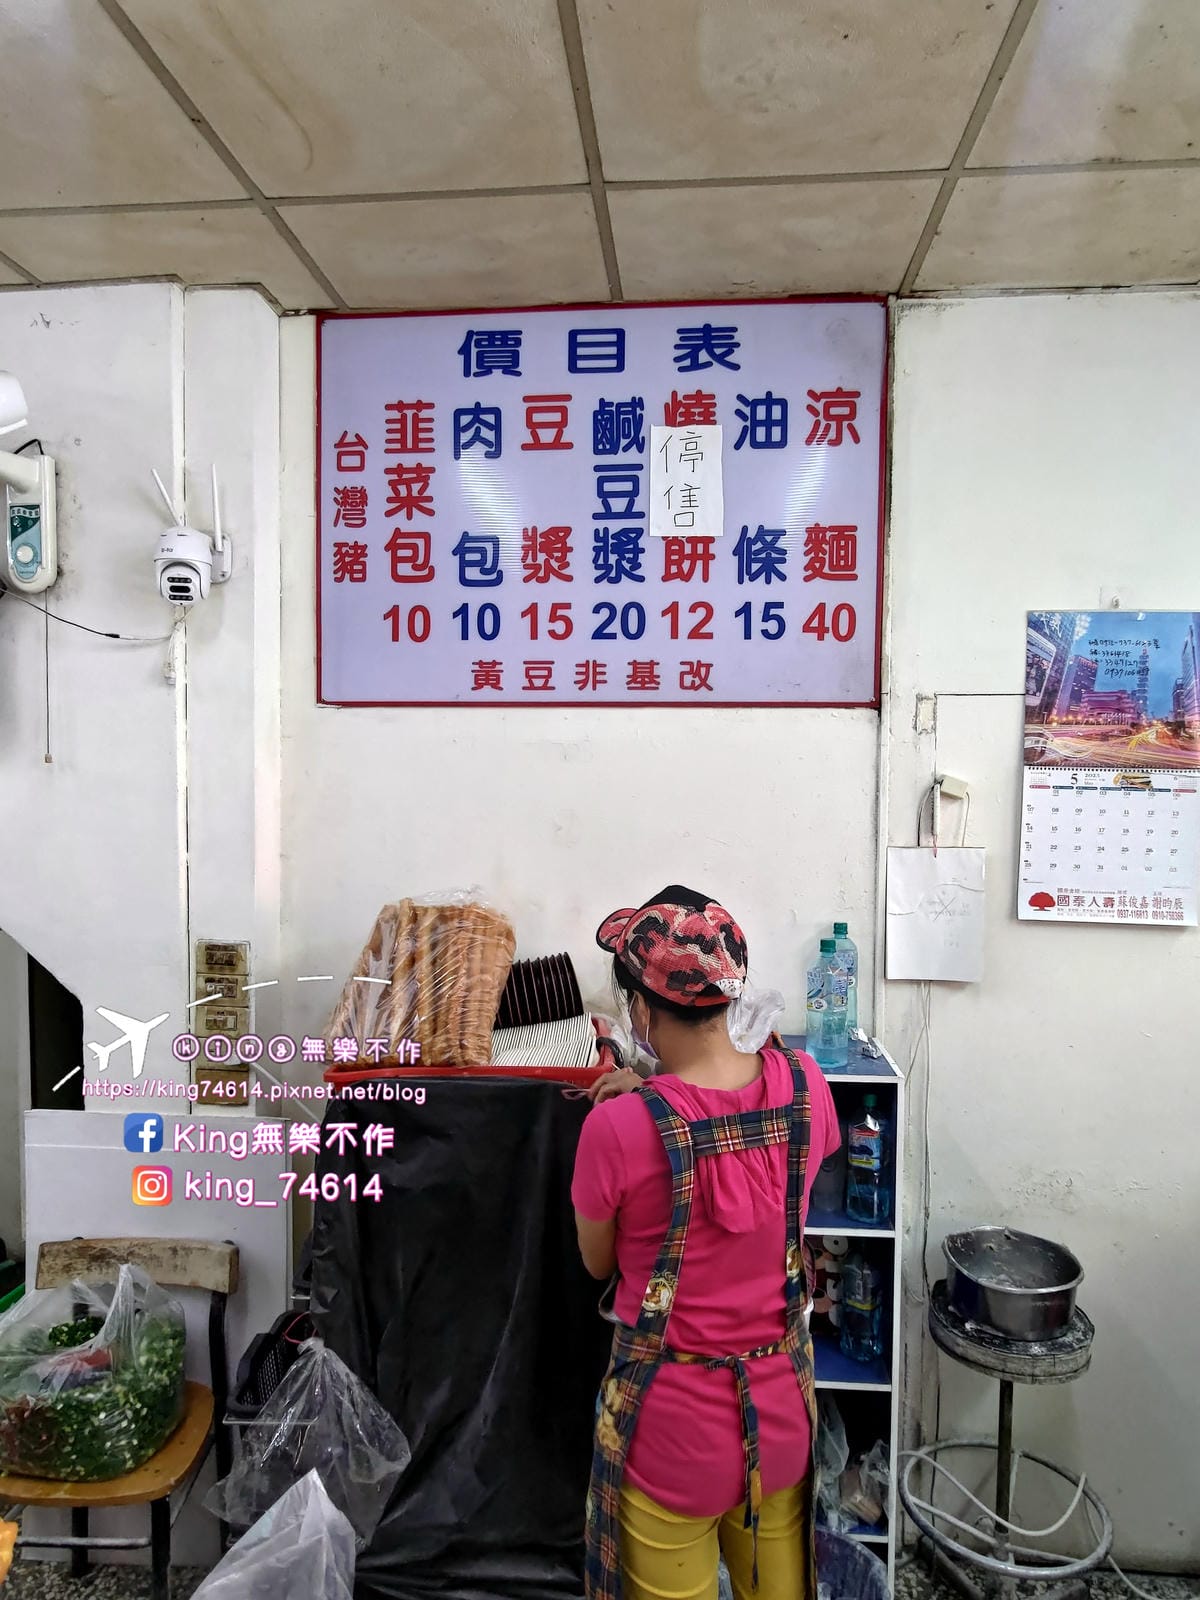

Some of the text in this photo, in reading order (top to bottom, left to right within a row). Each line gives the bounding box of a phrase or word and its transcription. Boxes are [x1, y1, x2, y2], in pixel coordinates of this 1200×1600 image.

[457, 323, 741, 378] 價目表
[333, 430, 369, 584] 台灣豬
[383, 400, 436, 584] 韭菜包
[451, 401, 503, 588] 肉包
[520, 394, 574, 585] 豆漿
[592, 396, 646, 586] 鹹豆漿
[732, 390, 788, 586] 油條
[802, 386, 861, 583] 涼麵
[383, 600, 858, 643] 10 10 15 20 12 15 40
[471, 659, 714, 692] 黃豆非基改
[1071, 773, 1078, 785] 5
[1057, 895, 1115, 908] 國泰人壽
